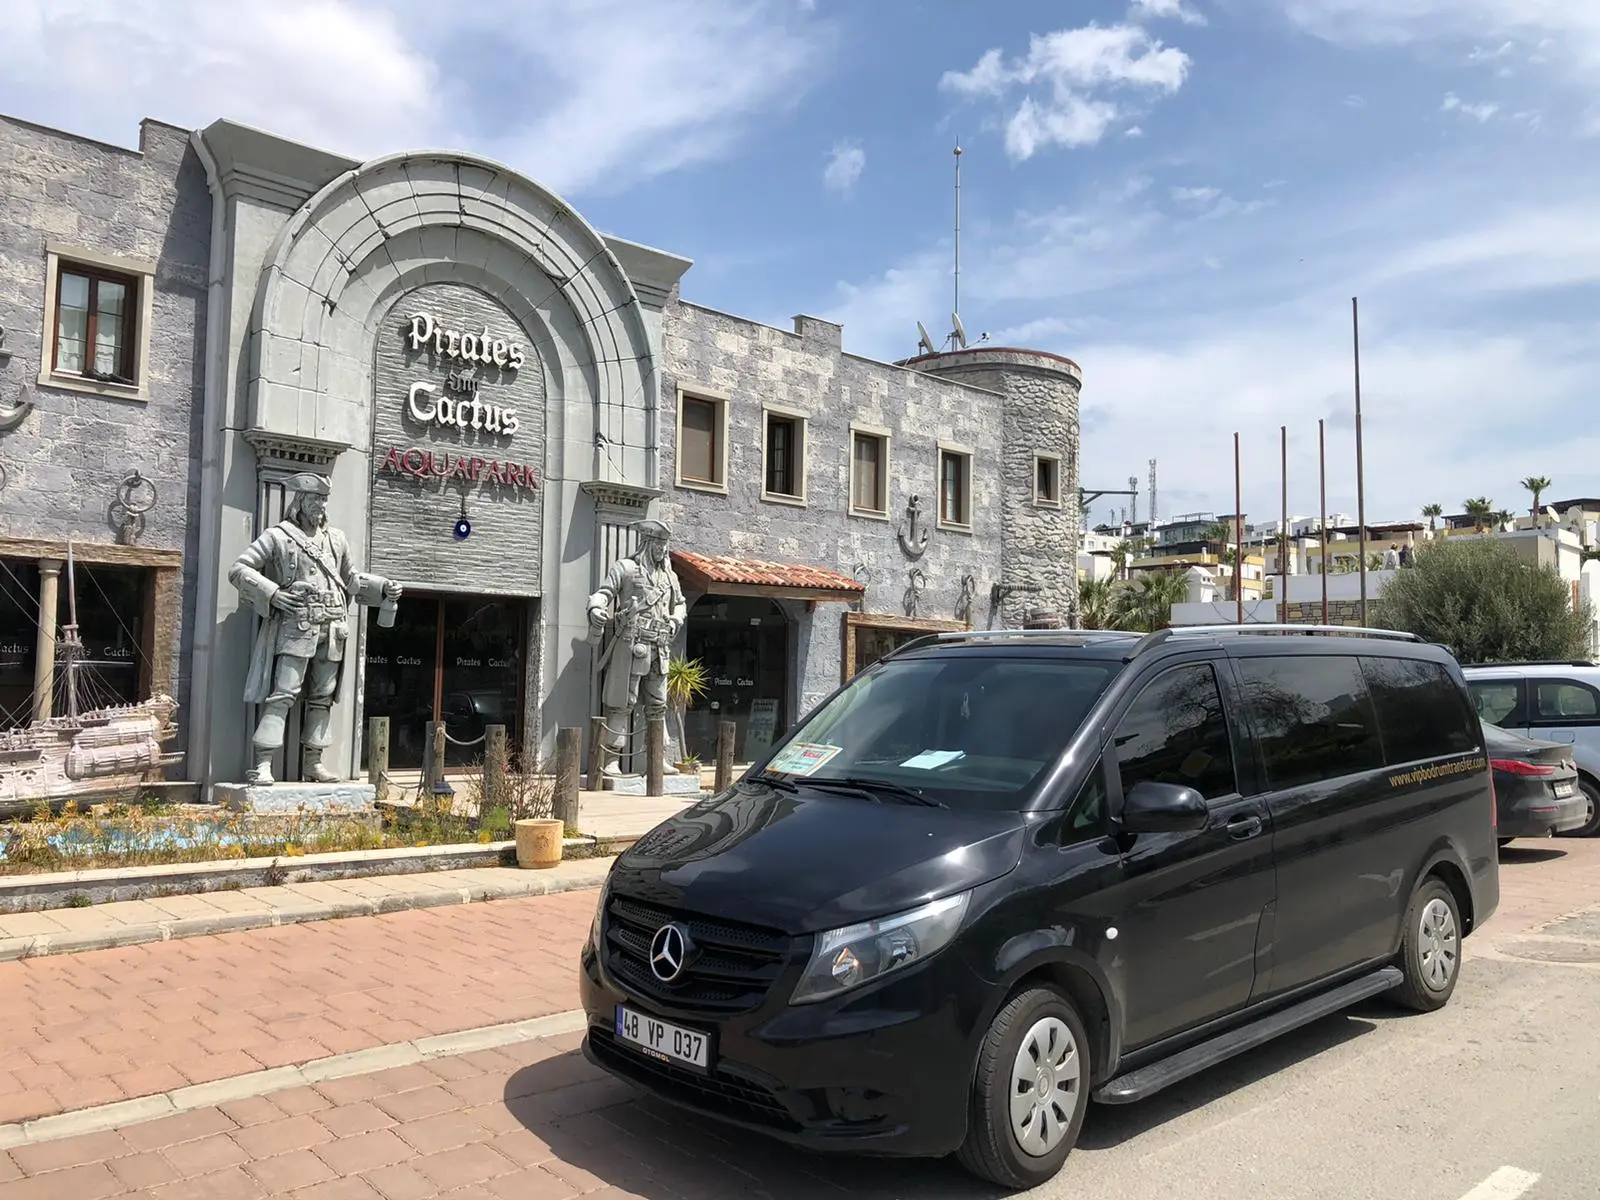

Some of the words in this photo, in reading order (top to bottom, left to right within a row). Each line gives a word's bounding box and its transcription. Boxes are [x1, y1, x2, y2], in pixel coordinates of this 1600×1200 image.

[405, 311, 525, 369] Pirates
[409, 381, 519, 436] Cactus
[381, 446, 540, 490] AQUAPARK
[396, 655, 422, 665] Cactus
[624, 1011, 639, 1039] 48
[648, 1020, 664, 1048] VP
[673, 1030, 702, 1062] 037
